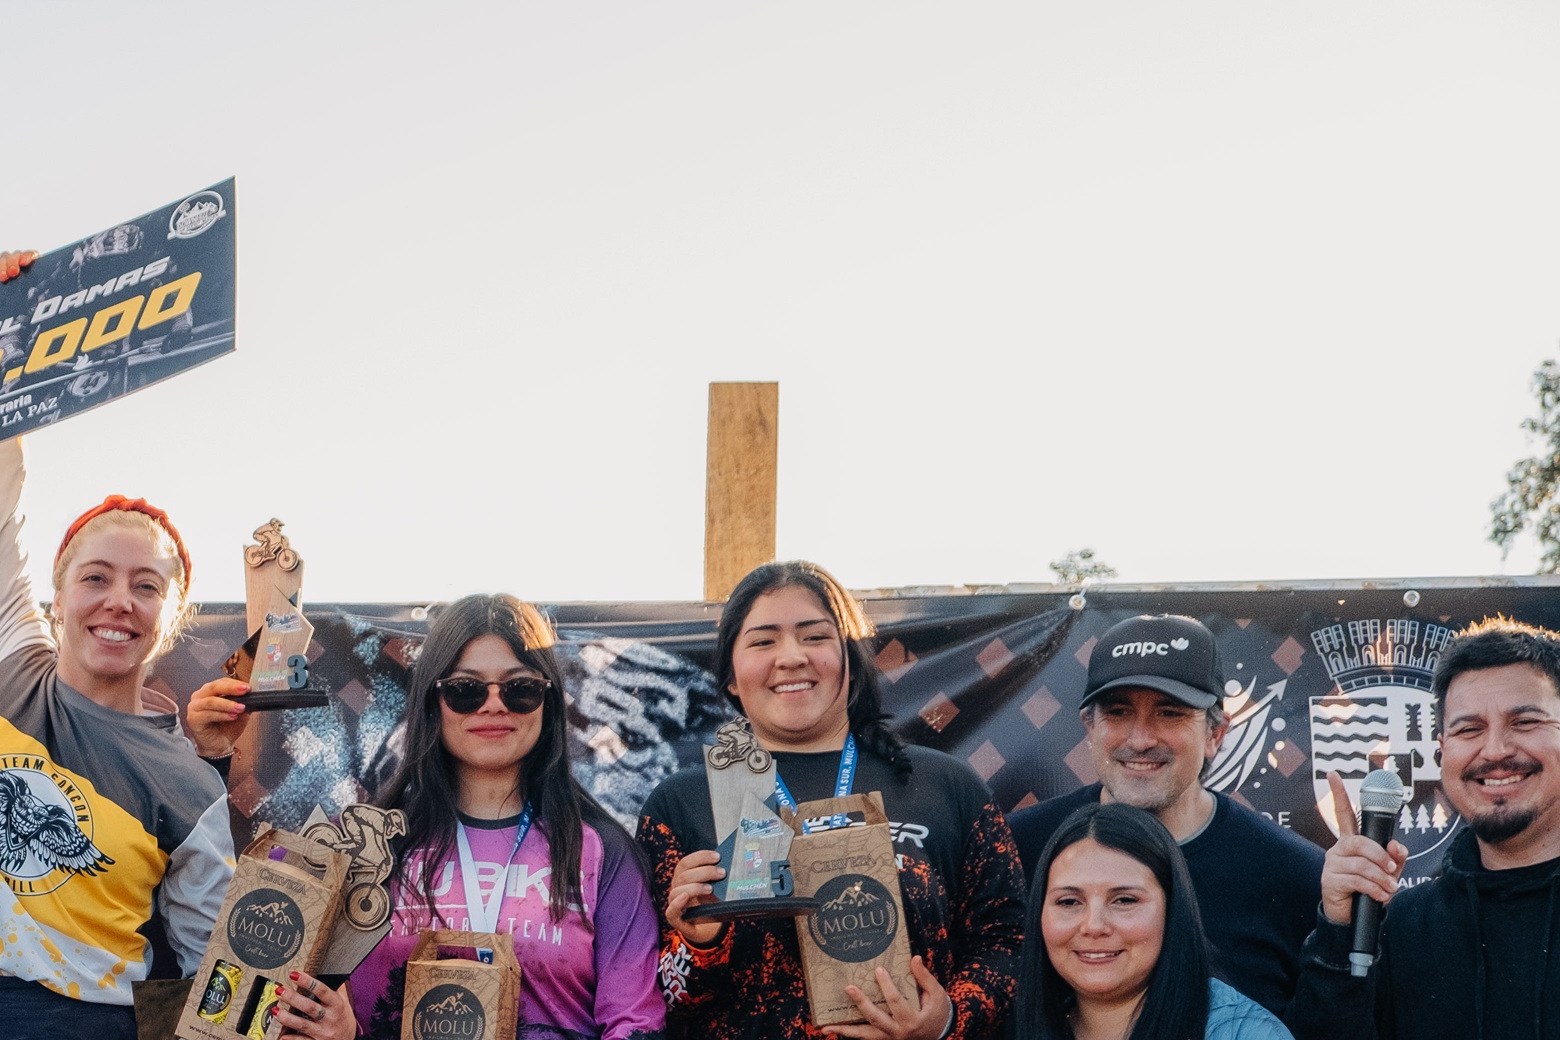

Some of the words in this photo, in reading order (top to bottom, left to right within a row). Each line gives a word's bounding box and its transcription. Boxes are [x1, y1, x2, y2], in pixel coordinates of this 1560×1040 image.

[30, 256, 171, 324] DAMAS
[1, 411, 23, 428] LA
[27, 396, 58, 419] PAZ
[1112, 641, 1170, 659] cmpc
[287, 654, 310, 689] 3
[2, 757, 45, 770] TEAM
[770, 860, 795, 897] 5
[238, 917, 291, 946] MOLU
[508, 918, 564, 946] TEAM
[824, 910, 885, 935] MOLU
[423, 1019, 475, 1036] MOLU
